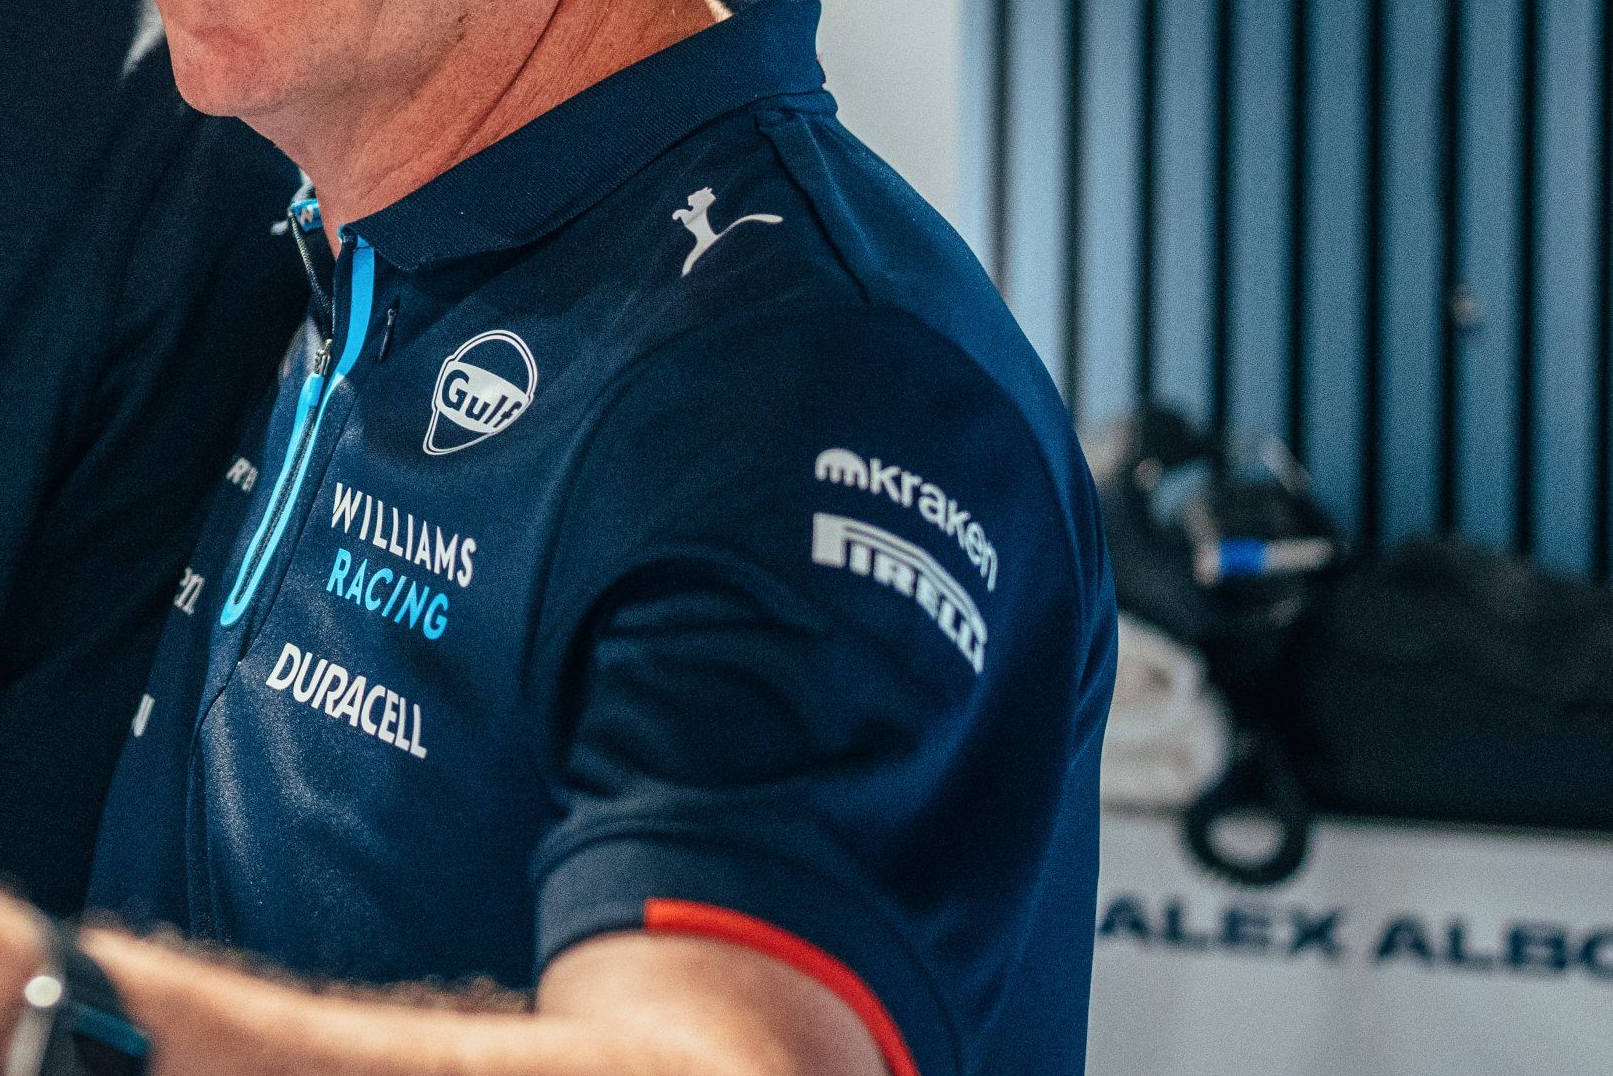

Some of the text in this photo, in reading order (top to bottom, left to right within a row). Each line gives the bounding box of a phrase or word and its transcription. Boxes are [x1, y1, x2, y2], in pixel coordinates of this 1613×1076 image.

[442, 369, 522, 428] Gulf
[332, 482, 476, 587] WILLIAMS
[326, 548, 449, 639] RACING
[812, 512, 987, 674] PIRELLI
[265, 642, 427, 759] DURACELL
[1099, 896, 1343, 960] ALEX
